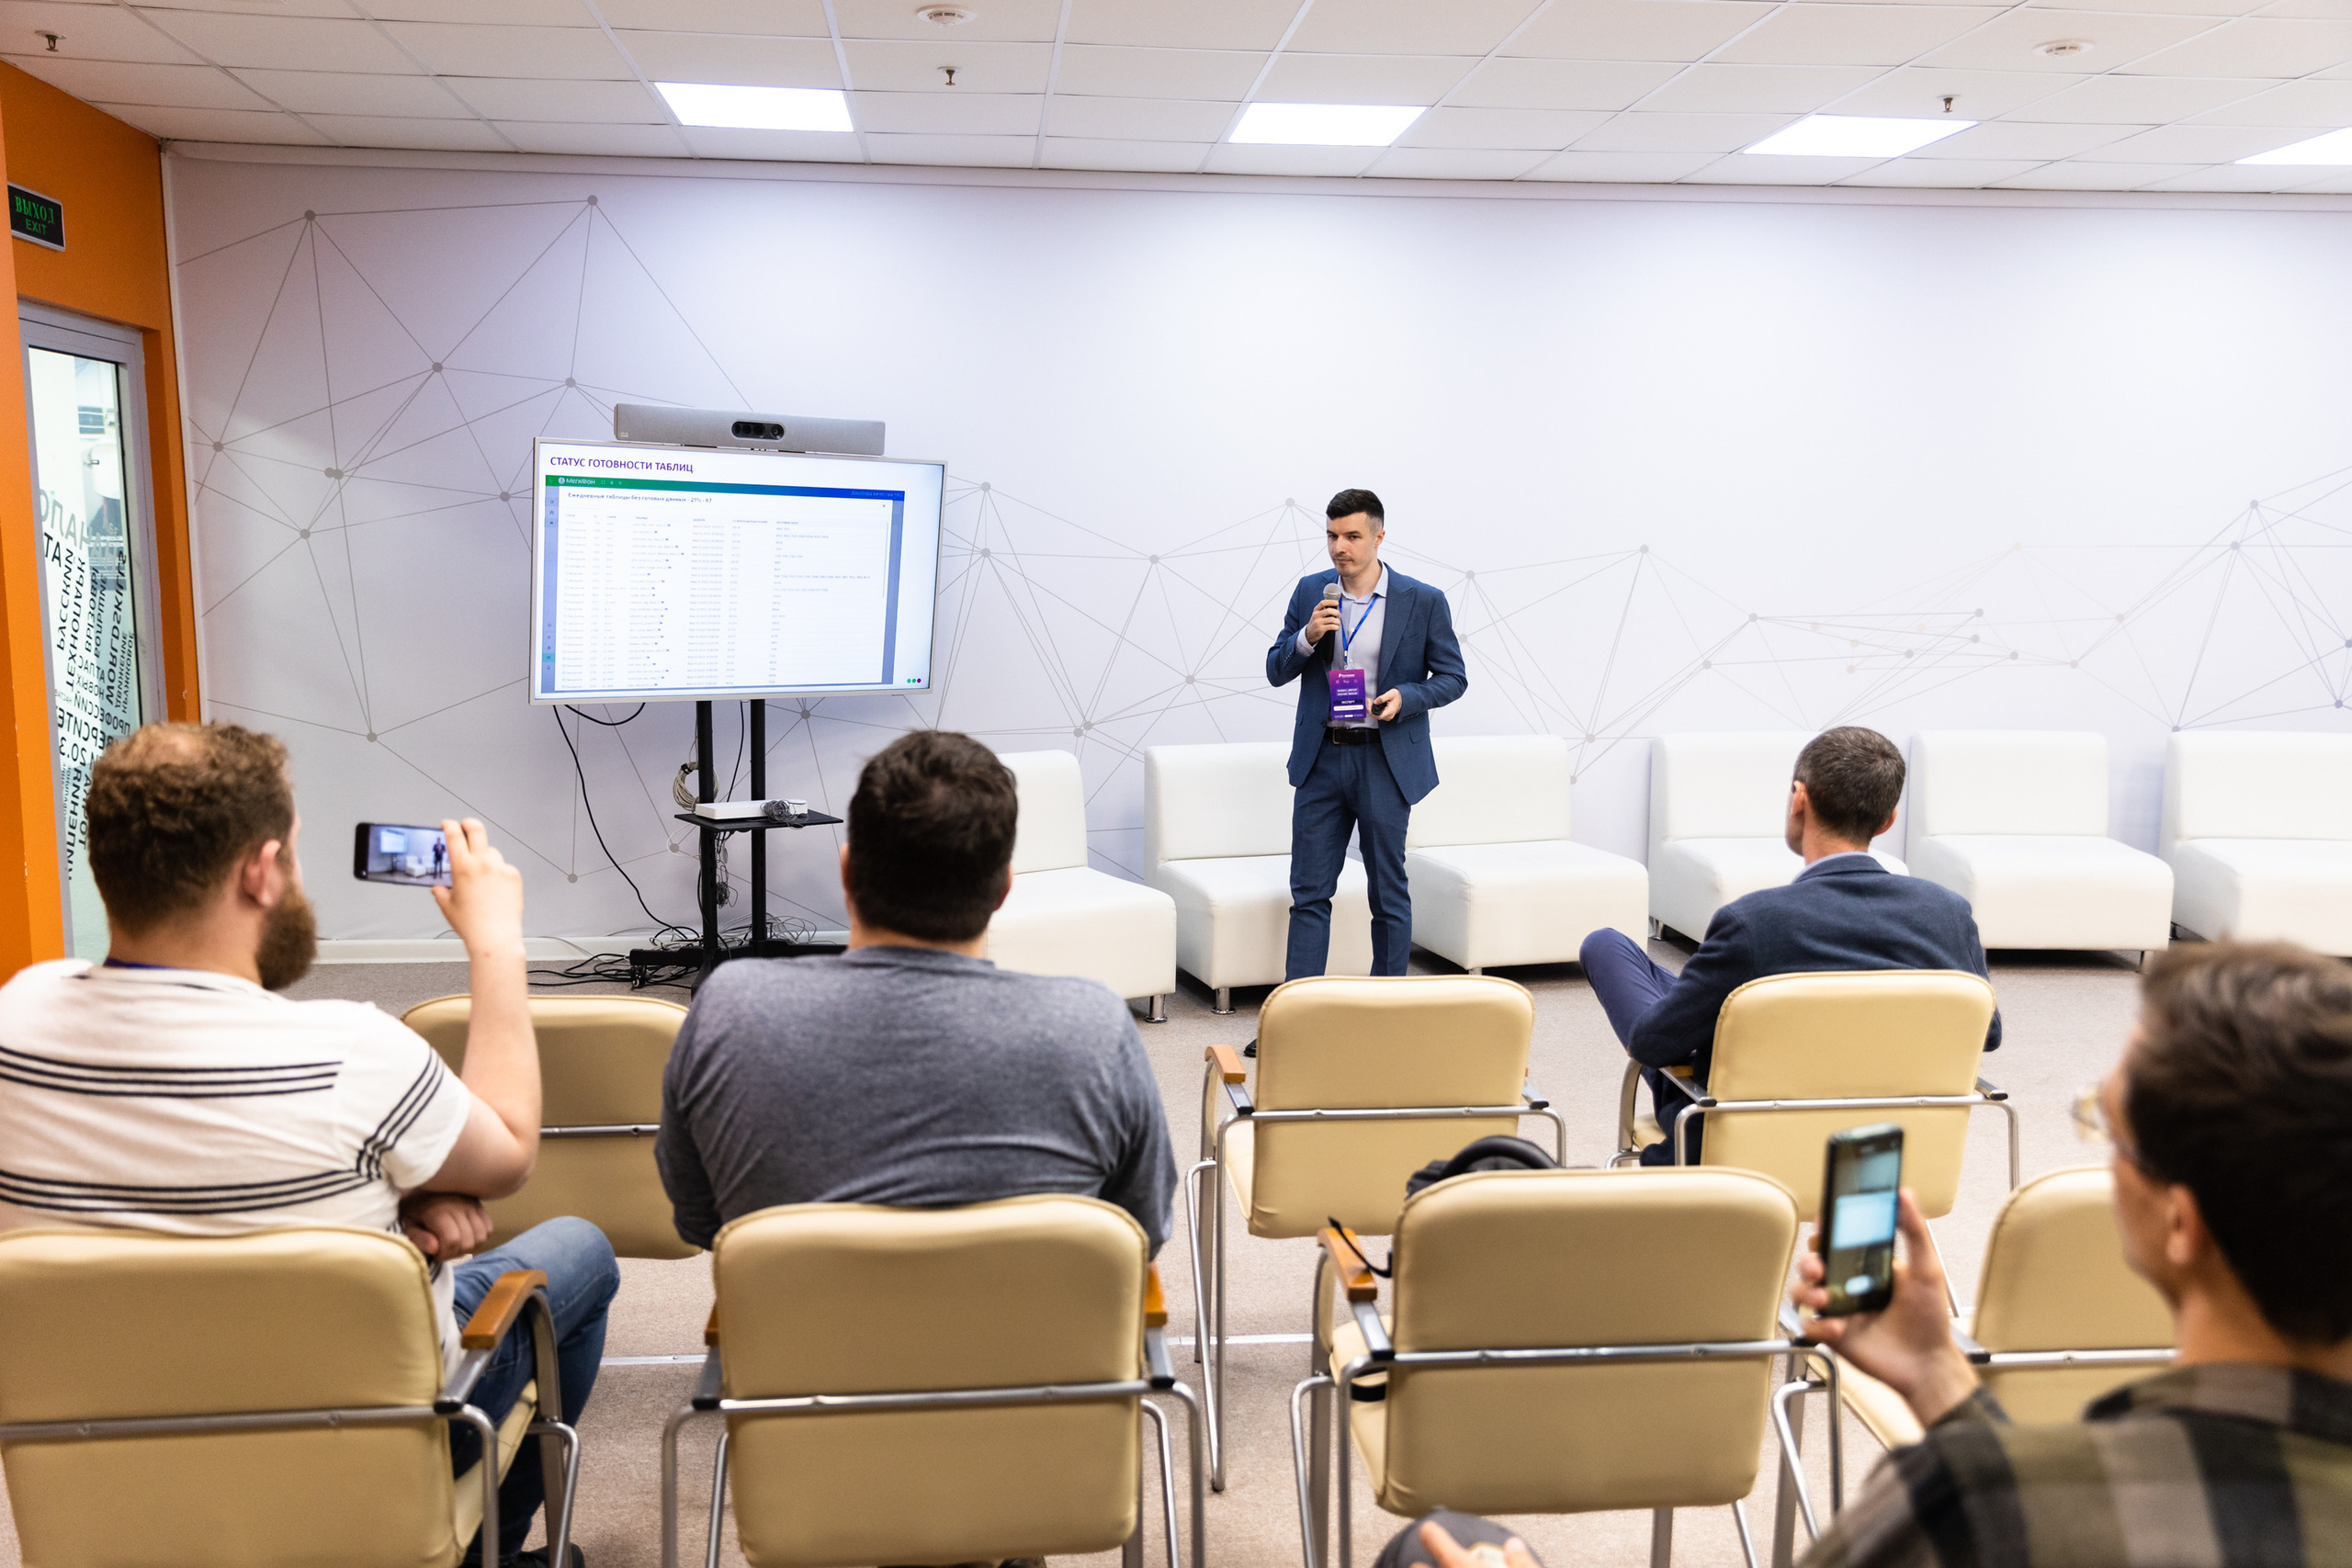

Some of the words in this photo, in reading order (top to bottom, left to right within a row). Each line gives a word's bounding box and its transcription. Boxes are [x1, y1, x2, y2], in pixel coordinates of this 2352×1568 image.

[15, 196, 55, 225] ВЫХОД
[26, 218, 47, 235] EXIT
[550, 457, 586, 468] СТАТУС
[588, 458, 653, 470] ГОТОВНОСТИ
[655, 462, 694, 474] ТАБЛИЦ
